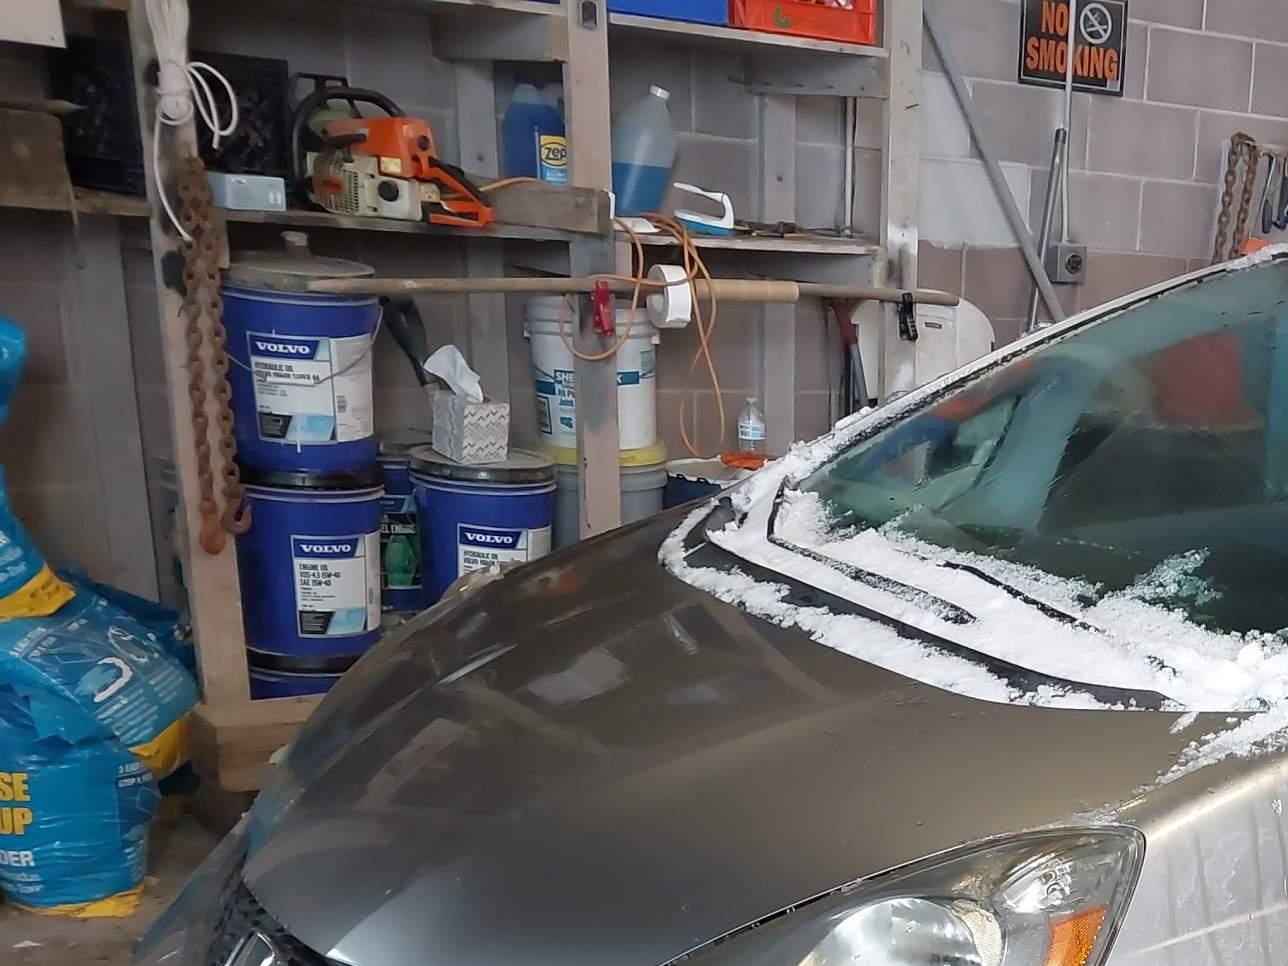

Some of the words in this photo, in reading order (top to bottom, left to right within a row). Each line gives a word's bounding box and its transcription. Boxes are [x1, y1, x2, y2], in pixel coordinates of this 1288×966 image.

[1041, 0, 1069, 36] NO
[1025, 36, 1118, 81] SMOKING
[255, 341, 310, 354] VOLVO
[464, 532, 513, 544] VOLVO
[300, 544, 351, 553] VOLVO
[0, 807, 33, 835] UP
